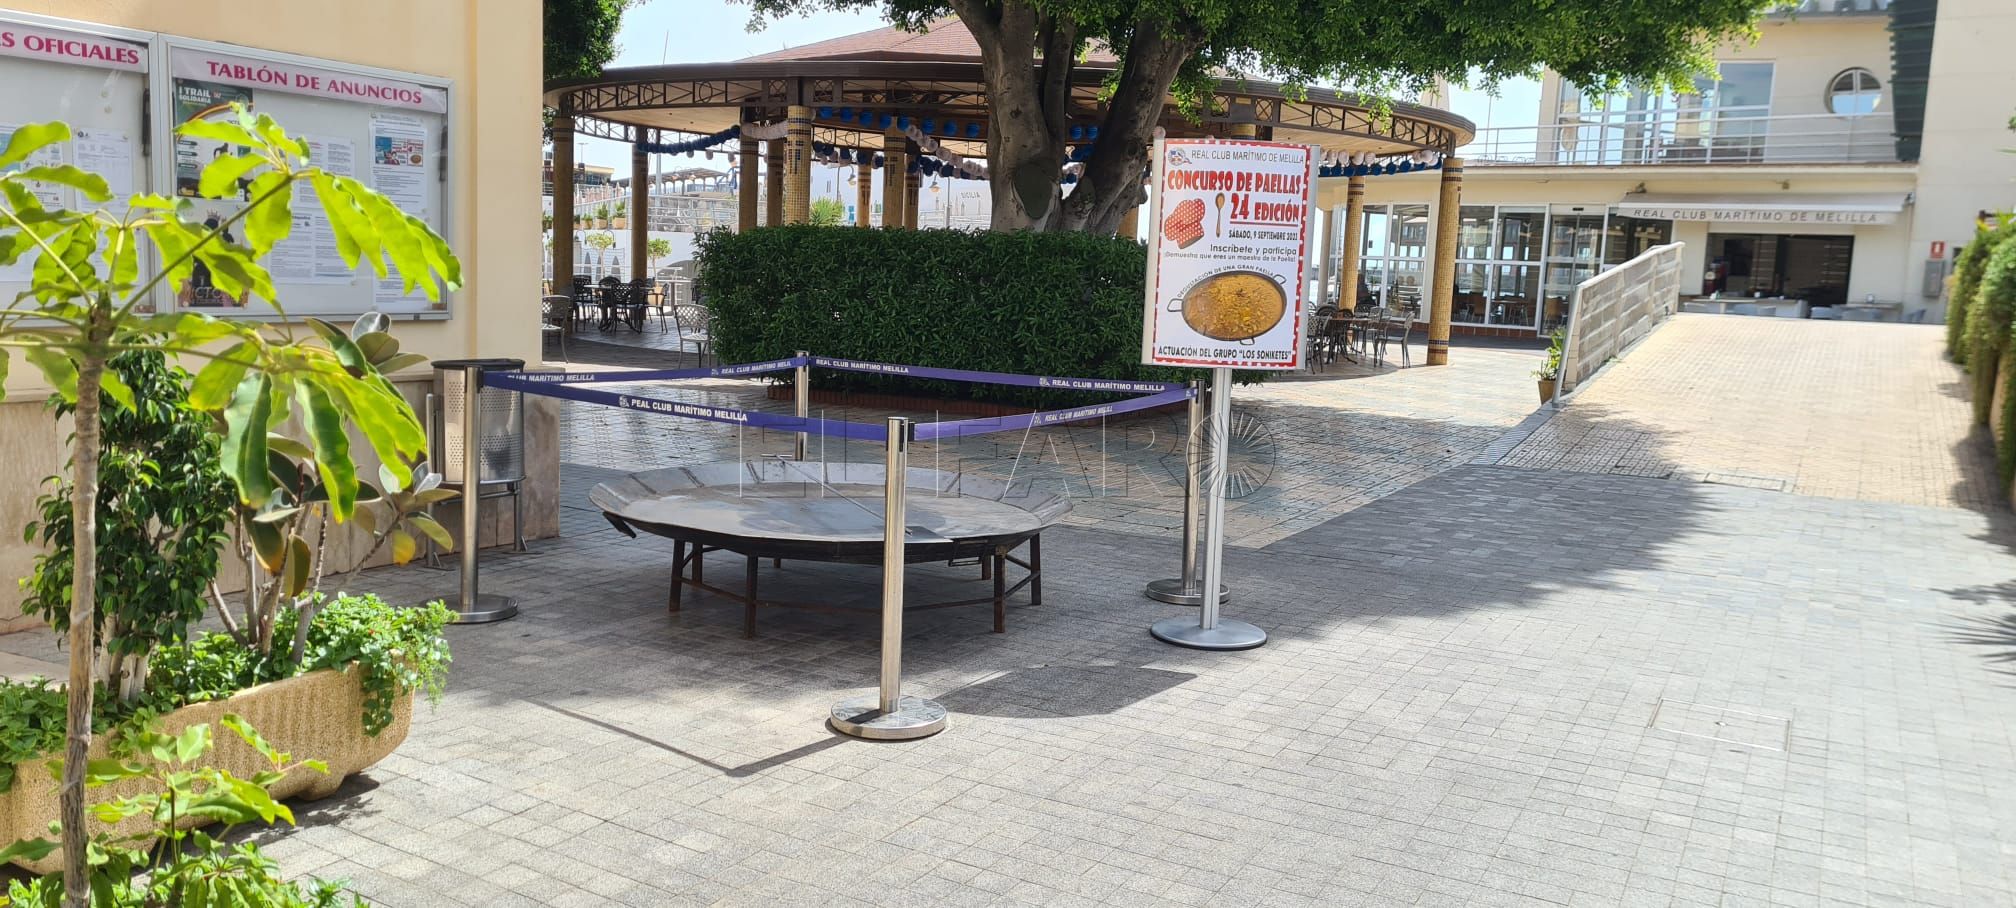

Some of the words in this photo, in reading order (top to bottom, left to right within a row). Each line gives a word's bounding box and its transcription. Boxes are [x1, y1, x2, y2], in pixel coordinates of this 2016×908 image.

[0, 32, 15, 48] S
[23, 35, 140, 64] OFICIALES
[206, 61, 288, 86] TABLÓN
[295, 74, 320, 90] DE
[327, 79, 422, 104] ANUNCIOS
[184, 87, 212, 98] TRAIL
[1191, 150, 1210, 160] REAL
[1211, 150, 1231, 160] CLUB
[1268, 152, 1278, 162] DE
[1279, 153, 1304, 164] MELILLA
[1167, 169, 1234, 192] CONCURSO
[1236, 171, 1253, 192] DE
[1255, 172, 1301, 195] PAELLAS
[1230, 193, 1250, 220] 24
[1254, 198, 1300, 223] EDICIÓN
[1633, 209, 1666, 218] REAL
[1672, 210, 1706, 220] CLUB
[1790, 211, 1808, 222] DE
[1815, 212, 1877, 223] MELILLA
[1257, 230, 1286, 240] SEPTIEMBRE
[1255, 247, 1260, 256] y
[1262, 246, 1297, 258] participa
[1158, 345, 1198, 356] ACTUACIÓN
[1200, 347, 1212, 357] DEL
[1213, 348, 1238, 358] GRUPO
[815, 358, 832, 366] REAL
[832, 360, 849, 368] CLUB
[882, 364, 909, 374] MELILLA
[1052, 379, 1071, 387] REAL
[1073, 380, 1092, 388] CLUB
[1133, 383, 1165, 391] MELILLA
[652, 401, 672, 412] CLUB
[714, 409, 748, 421] MELILLA
